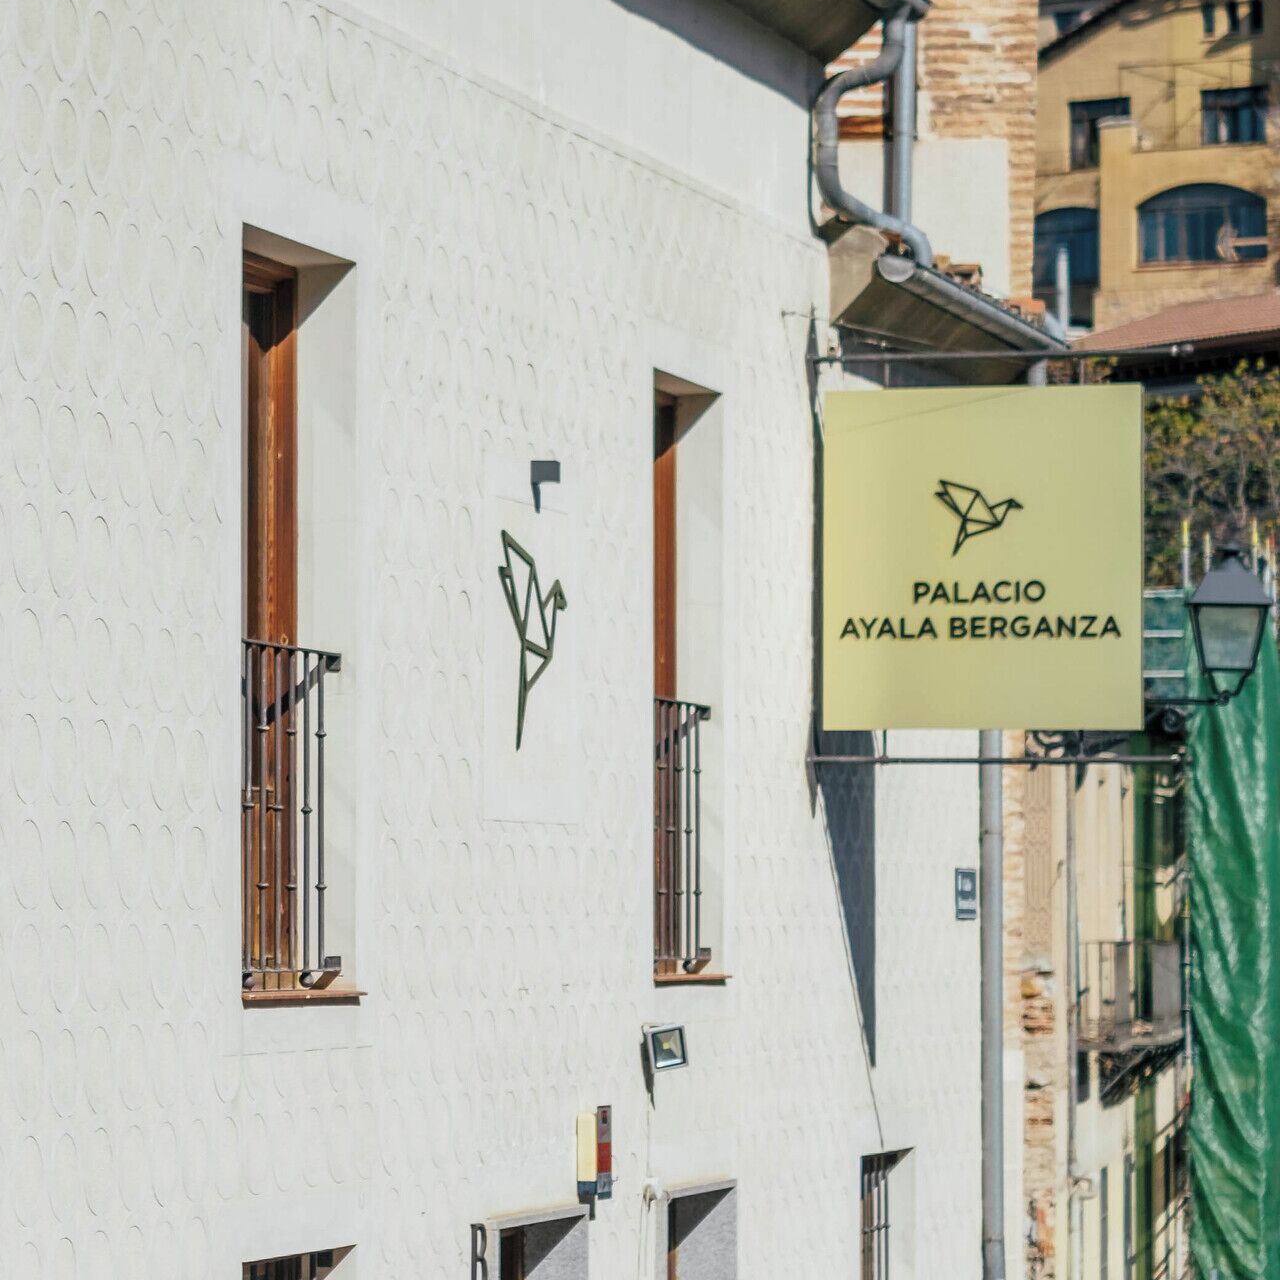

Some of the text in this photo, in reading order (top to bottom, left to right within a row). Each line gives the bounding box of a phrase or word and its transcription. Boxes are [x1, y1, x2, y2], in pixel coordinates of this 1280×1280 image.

[913, 580, 1046, 604] PALACIO
[840, 615, 1122, 639] AYALA BERGANZA
